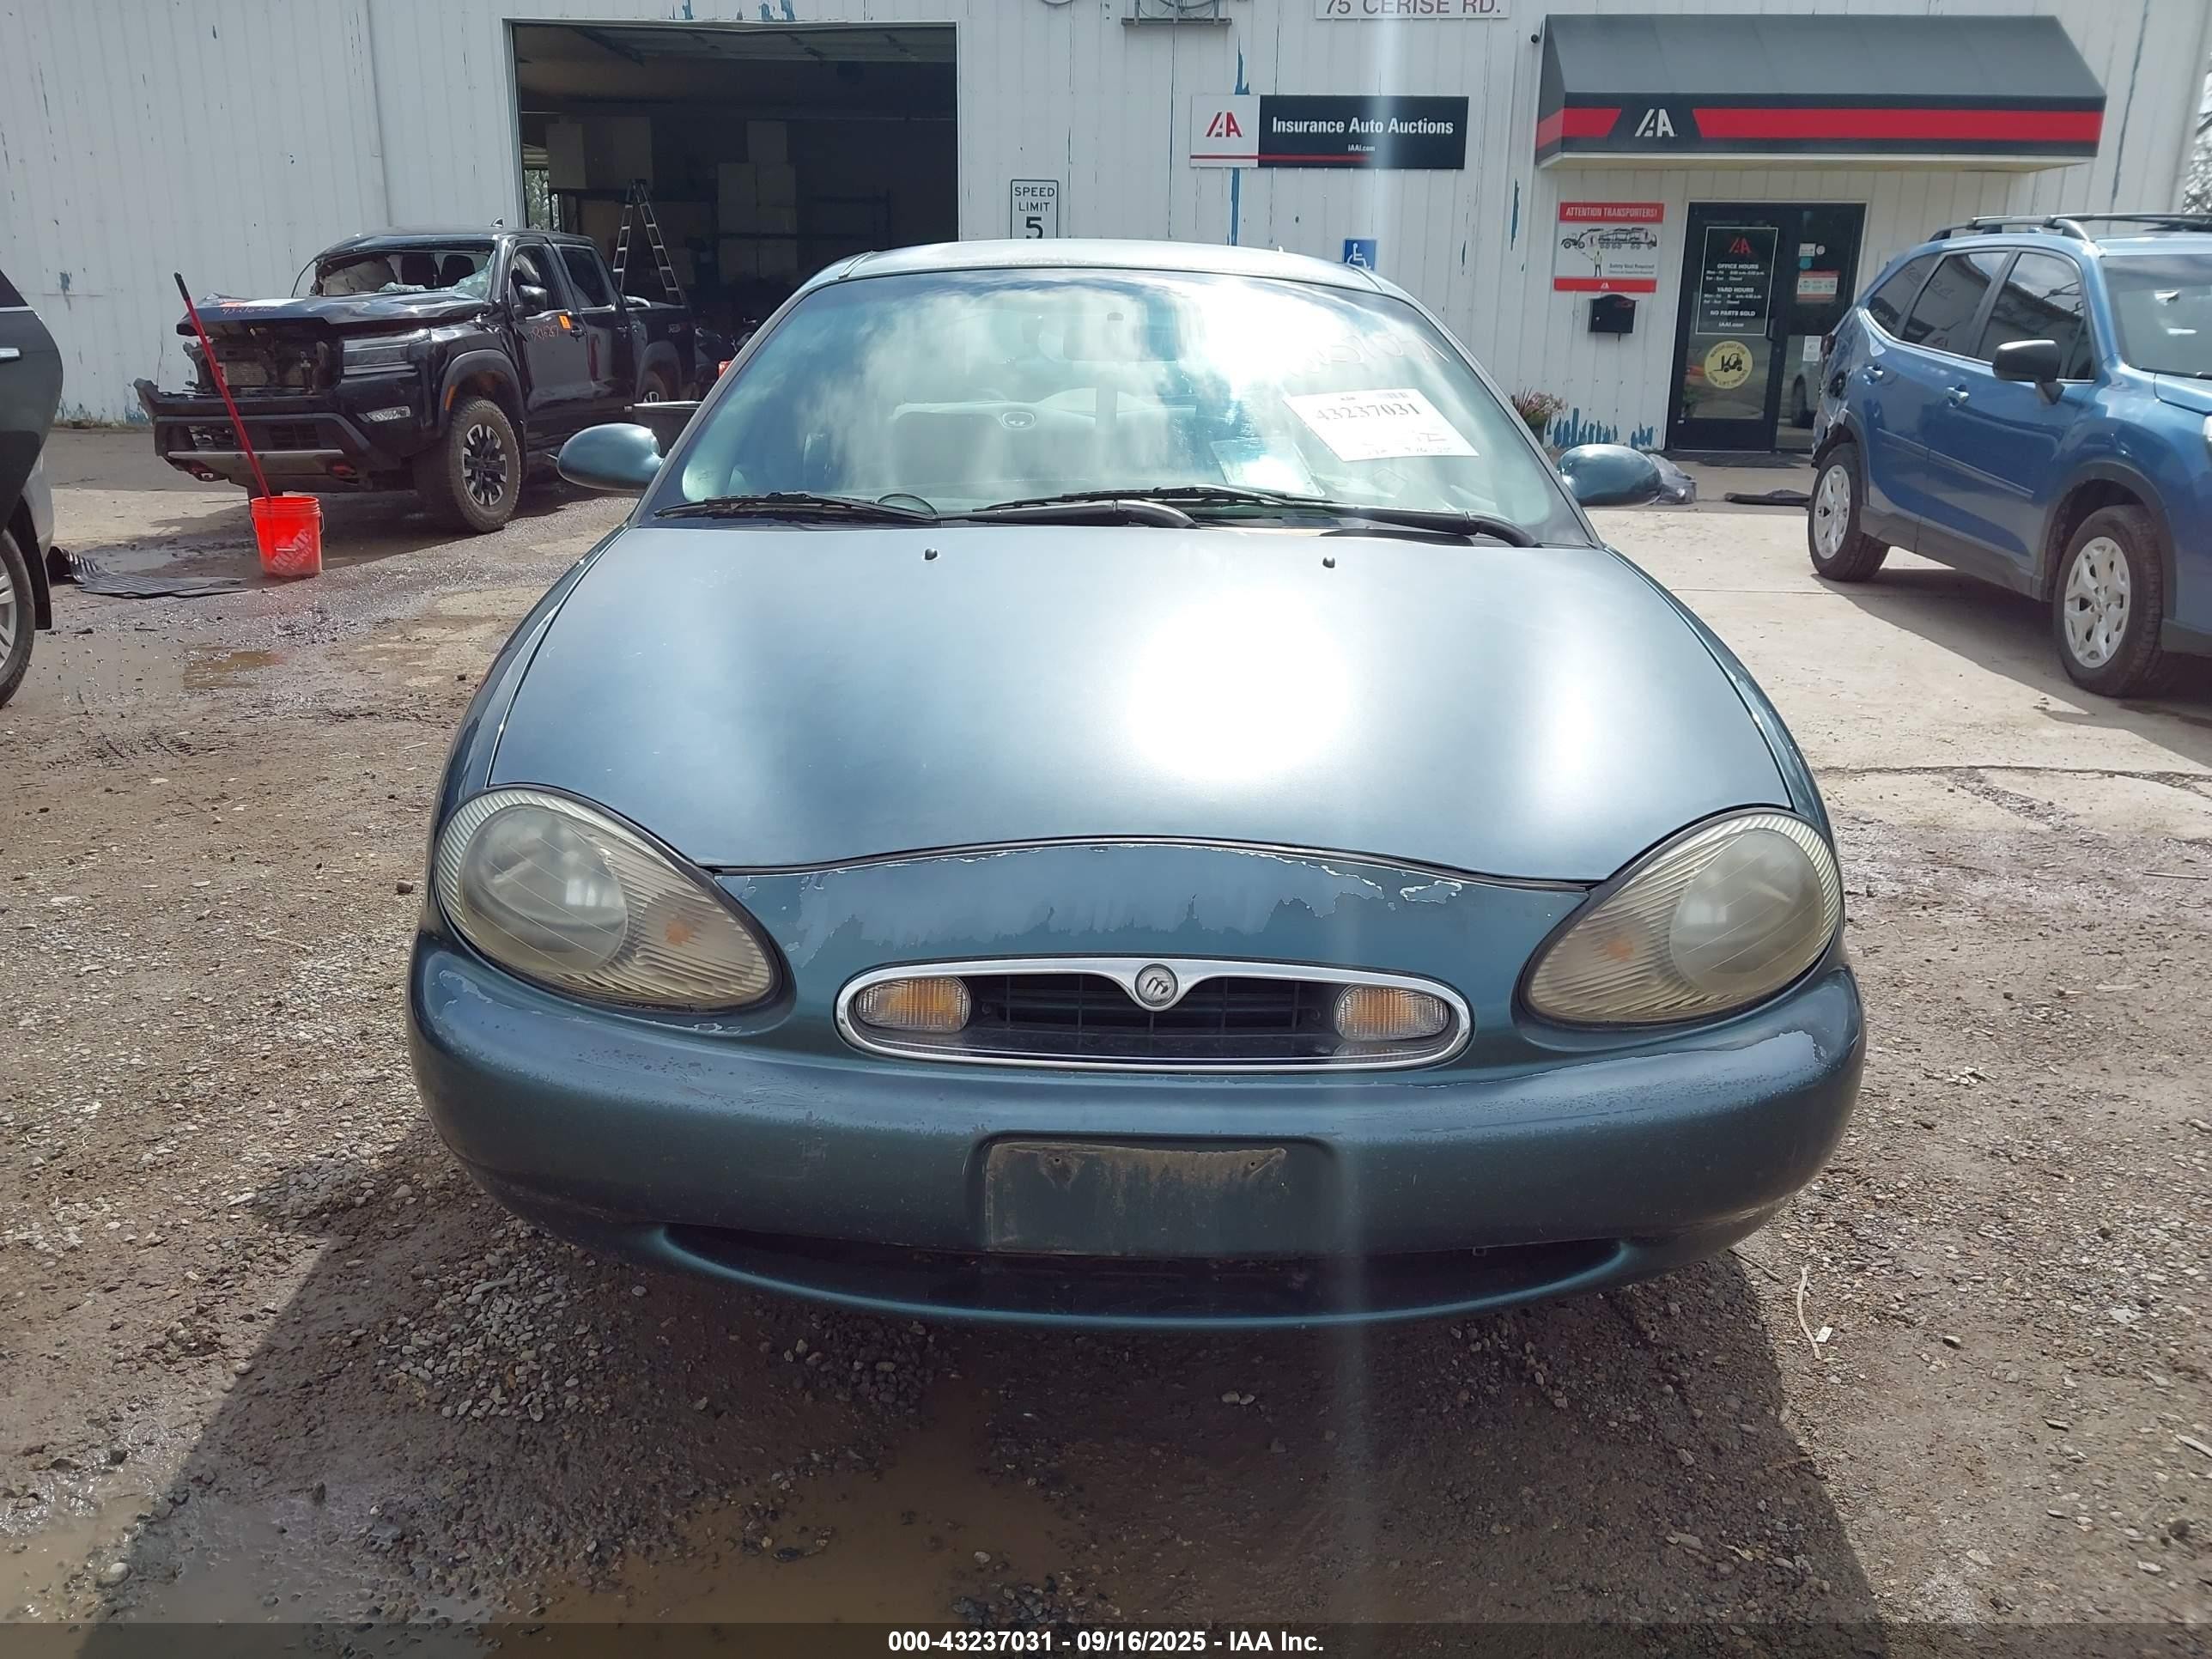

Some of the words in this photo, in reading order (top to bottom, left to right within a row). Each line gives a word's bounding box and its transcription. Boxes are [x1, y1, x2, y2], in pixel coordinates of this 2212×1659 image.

[1325, 0, 1352, 14] 75
[1362, 0, 1450, 14] CERISE
[1462, 0, 1501, 14] RD.
[1272, 116, 1345, 134] Insurance
[1348, 117, 1383, 134] Auto
[1388, 117, 1454, 135] Auctions
[1014, 186, 1055, 198] SPEED
[1018, 201, 1050, 212] LIMIT
[1565, 206, 1602, 217] ATTENTION
[1025, 216, 1043, 239] 5
[1316, 403, 1422, 421] 43237031
